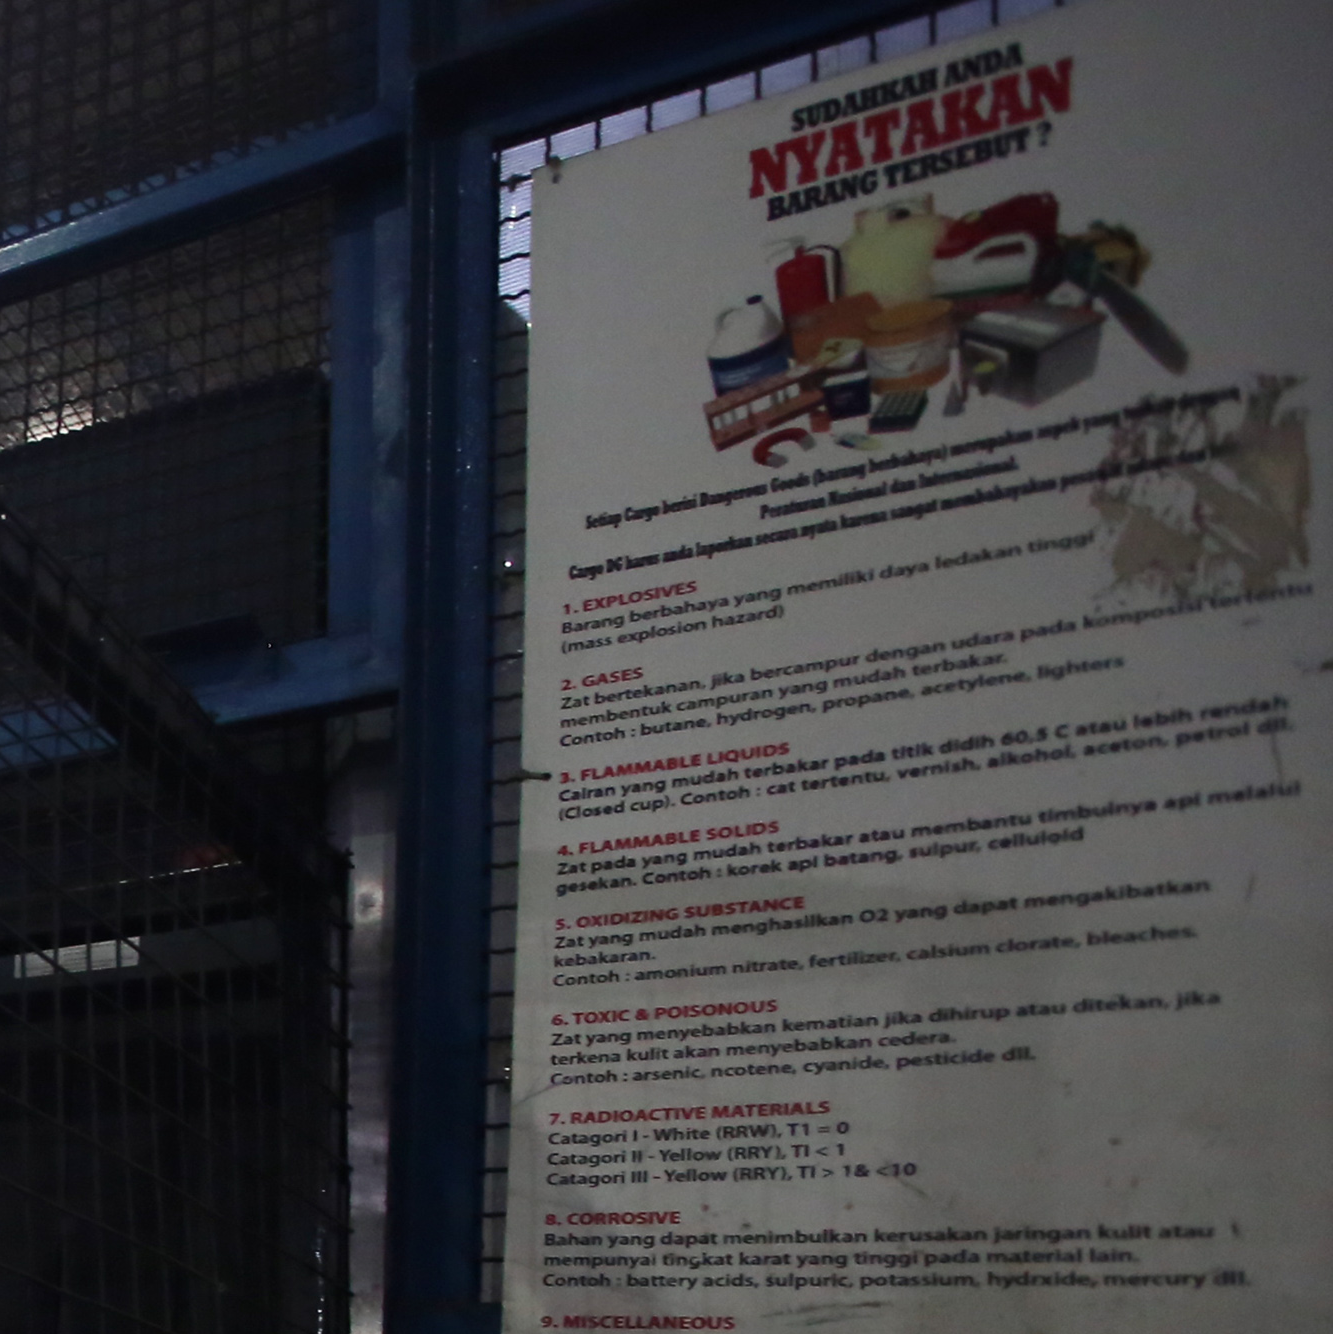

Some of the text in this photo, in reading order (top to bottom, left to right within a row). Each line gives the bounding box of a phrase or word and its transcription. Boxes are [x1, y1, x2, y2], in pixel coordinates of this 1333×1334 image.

[791, 42, 1023, 132] SUDAHKAH ANDA
[749, 56, 1073, 198] NYATAKAN
[767, 168, 879, 221] BARANG
[883, 128, 1030, 188] TERSEBUT
[561, 530, 1095, 635] Barang berbahaya yang memiliki daya ledakan tinggi
[563, 580, 698, 615] 1. EXPLOSIVES
[561, 604, 784, 655] (mass explosion hazard)
[560, 695, 590, 710] Zat
[593, 680, 706, 705] bertekanan,
[710, 672, 745, 691] jika
[749, 655, 860, 682] bercampur
[864, 641, 947, 663] dengan
[951, 630, 1015, 650] udara
[1019, 619, 1077, 643] pada
[560, 666, 644, 692] 2. GASES
[560, 653, 1007, 729] membentuk campuran yang mudah terbakar.
[559, 726, 626, 748] Contoh
[639, 717, 712, 737] butane,
[716, 702, 817, 726] hydrogen,
[821, 687, 915, 713] propane,
[559, 741, 790, 785] 3. FLAMMABLE LIQUIDS
[556, 820, 780, 857] 4. FLAMMABLE SOLIDS
[553, 880, 1211, 950] Zat yang mudah menghasilkan O2 yang dapat mengakibatkan
[555, 895, 805, 932] 5. OXIDIZING SUBSTANCE
[553, 950, 656, 968] kebakaran.
[550, 999, 778, 1027] 6. TOXIC & POISONOUS
[550, 1030, 956, 1066] terkena kulit akan menyebabkan cedera.
[549, 1100, 831, 1126] 7. RADIOACTIVE MATERIALS
[547, 1129, 628, 1147] Catagori
[652, 1127, 711, 1142] White
[715, 1123, 782, 1141] (RRW),
[543, 1223, 1215, 1250] Bahan yang dapat menimbulkan kerusakan jaringan kulit atau
[544, 1210, 682, 1227] 8. CORROSIVE
[540, 1314, 736, 1331] 9. MISCELLANEOUS
